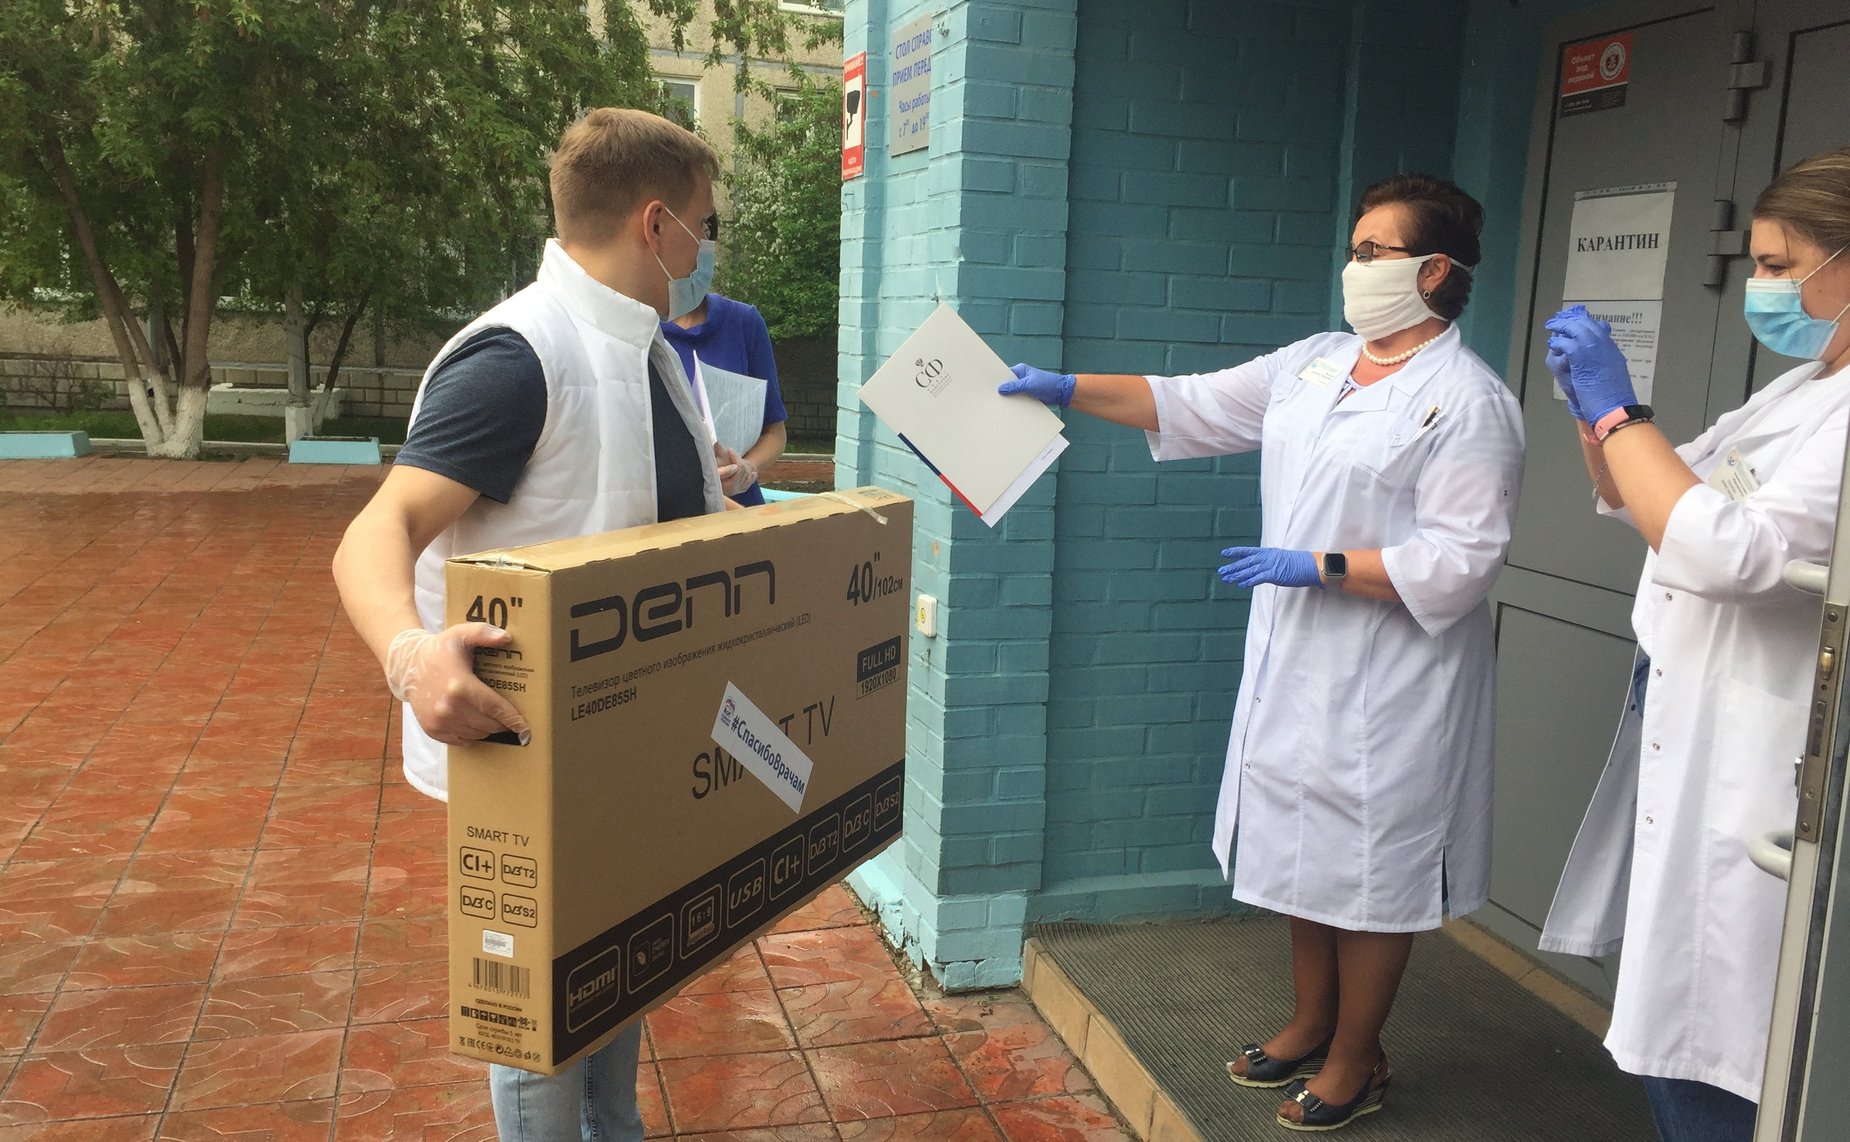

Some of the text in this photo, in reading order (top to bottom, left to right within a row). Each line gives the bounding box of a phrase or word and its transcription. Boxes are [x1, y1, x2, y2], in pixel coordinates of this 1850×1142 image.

[895, 29, 932, 60] СТОЛ СПРАВ
[892, 65, 912, 87] ПРИЕМ
[898, 100, 912, 113] Часы
[1577, 232, 1660, 253] КАРАНТИН
[1587, 312, 1643, 324] нимание!!!
[466, 594, 523, 631] 40"
[570, 674, 620, 700] Телевизор
[622, 660, 662, 684] цветного
[663, 644, 716, 670] изображения
[716, 616, 796, 654] жидкокристаллический
[862, 644, 897, 674] FULL HD
[860, 667, 898, 696] 1920X1080
[570, 687, 637, 722] LE40DE85SH
[691, 695, 835, 800] SMT TV
[730, 715, 806, 795] #СпасибоВрачам
[466, 826, 530, 848] SMART TV
[462, 854, 492, 874] CI+
[774, 854, 800, 885] CI+
[730, 876, 762, 910] USB
